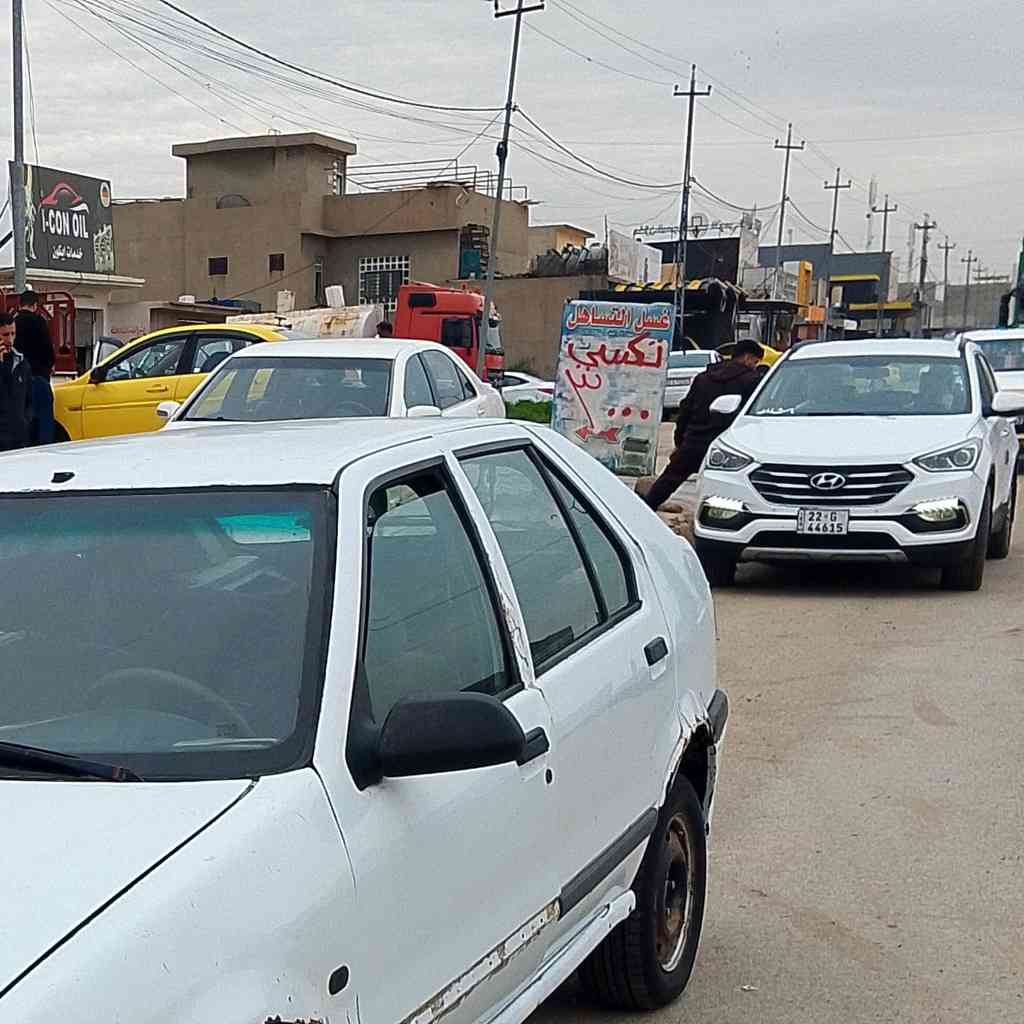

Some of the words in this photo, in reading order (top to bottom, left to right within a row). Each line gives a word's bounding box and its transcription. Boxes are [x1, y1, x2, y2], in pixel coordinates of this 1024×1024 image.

[41, 208, 70, 236] I-CON
[72, 212, 89, 239] OIL
[567, 304, 631, 330] التساهل
[633, 308, 671, 333] غسل
[807, 523, 844, 533] 44615
[808, 511, 822, 522] 22
[830, 511, 837, 522] G
